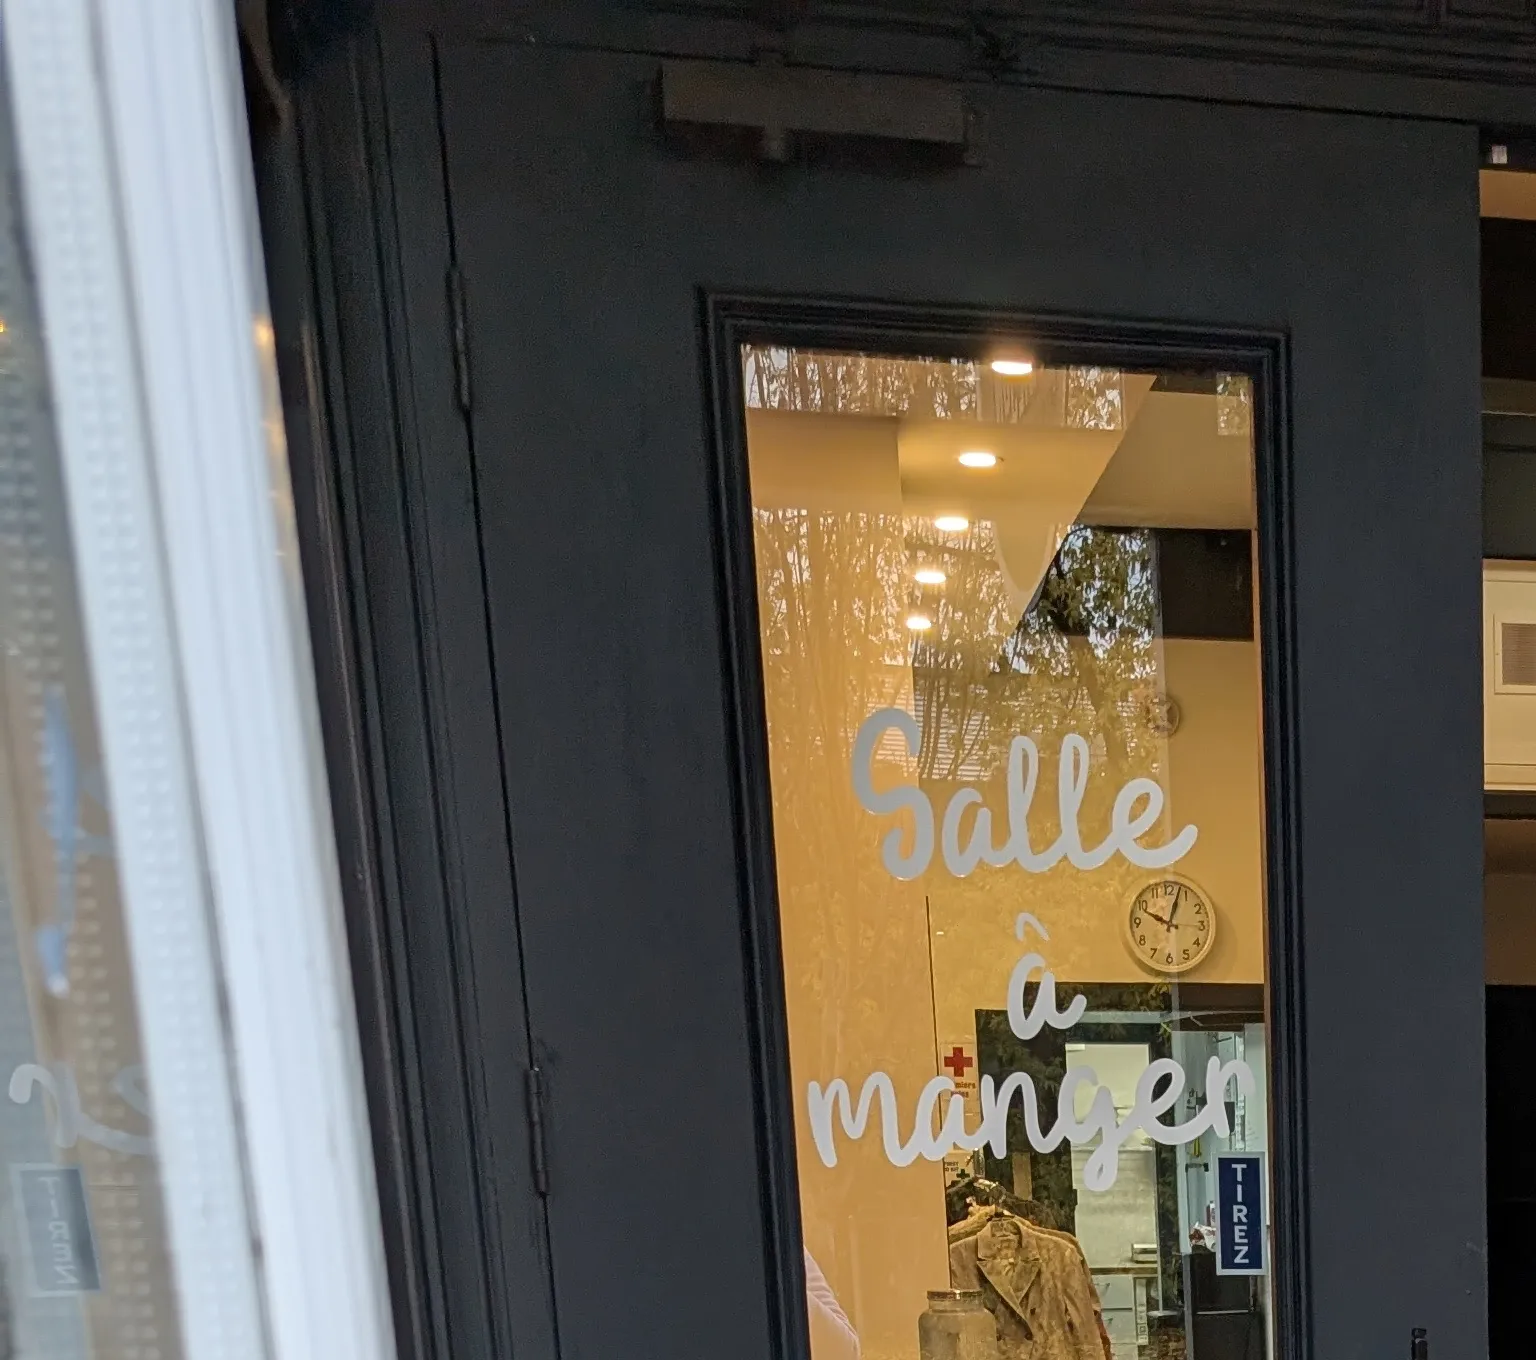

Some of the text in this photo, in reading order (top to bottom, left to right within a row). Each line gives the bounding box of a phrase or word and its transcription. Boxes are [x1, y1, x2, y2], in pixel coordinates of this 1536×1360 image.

[852, 707, 1199, 880] Salle
[1151, 887, 1159, 899] 11
[1164, 884, 1174, 896] 12
[1138, 900, 1148, 912] 10
[1194, 903, 1202, 914] 2
[1133, 917, 1141, 928] 9
[1198, 920, 1206, 931] 3
[1139, 934, 1146, 946] 8
[1192, 937, 1200, 947] 4
[1150, 947, 1157, 959] 7
[1166, 952, 1174, 964] 6
[1182, 949, 1190, 960] 5
[807, 1055, 1256, 1191] manger
[1231, 1163, 1250, 1264] TIREZ
